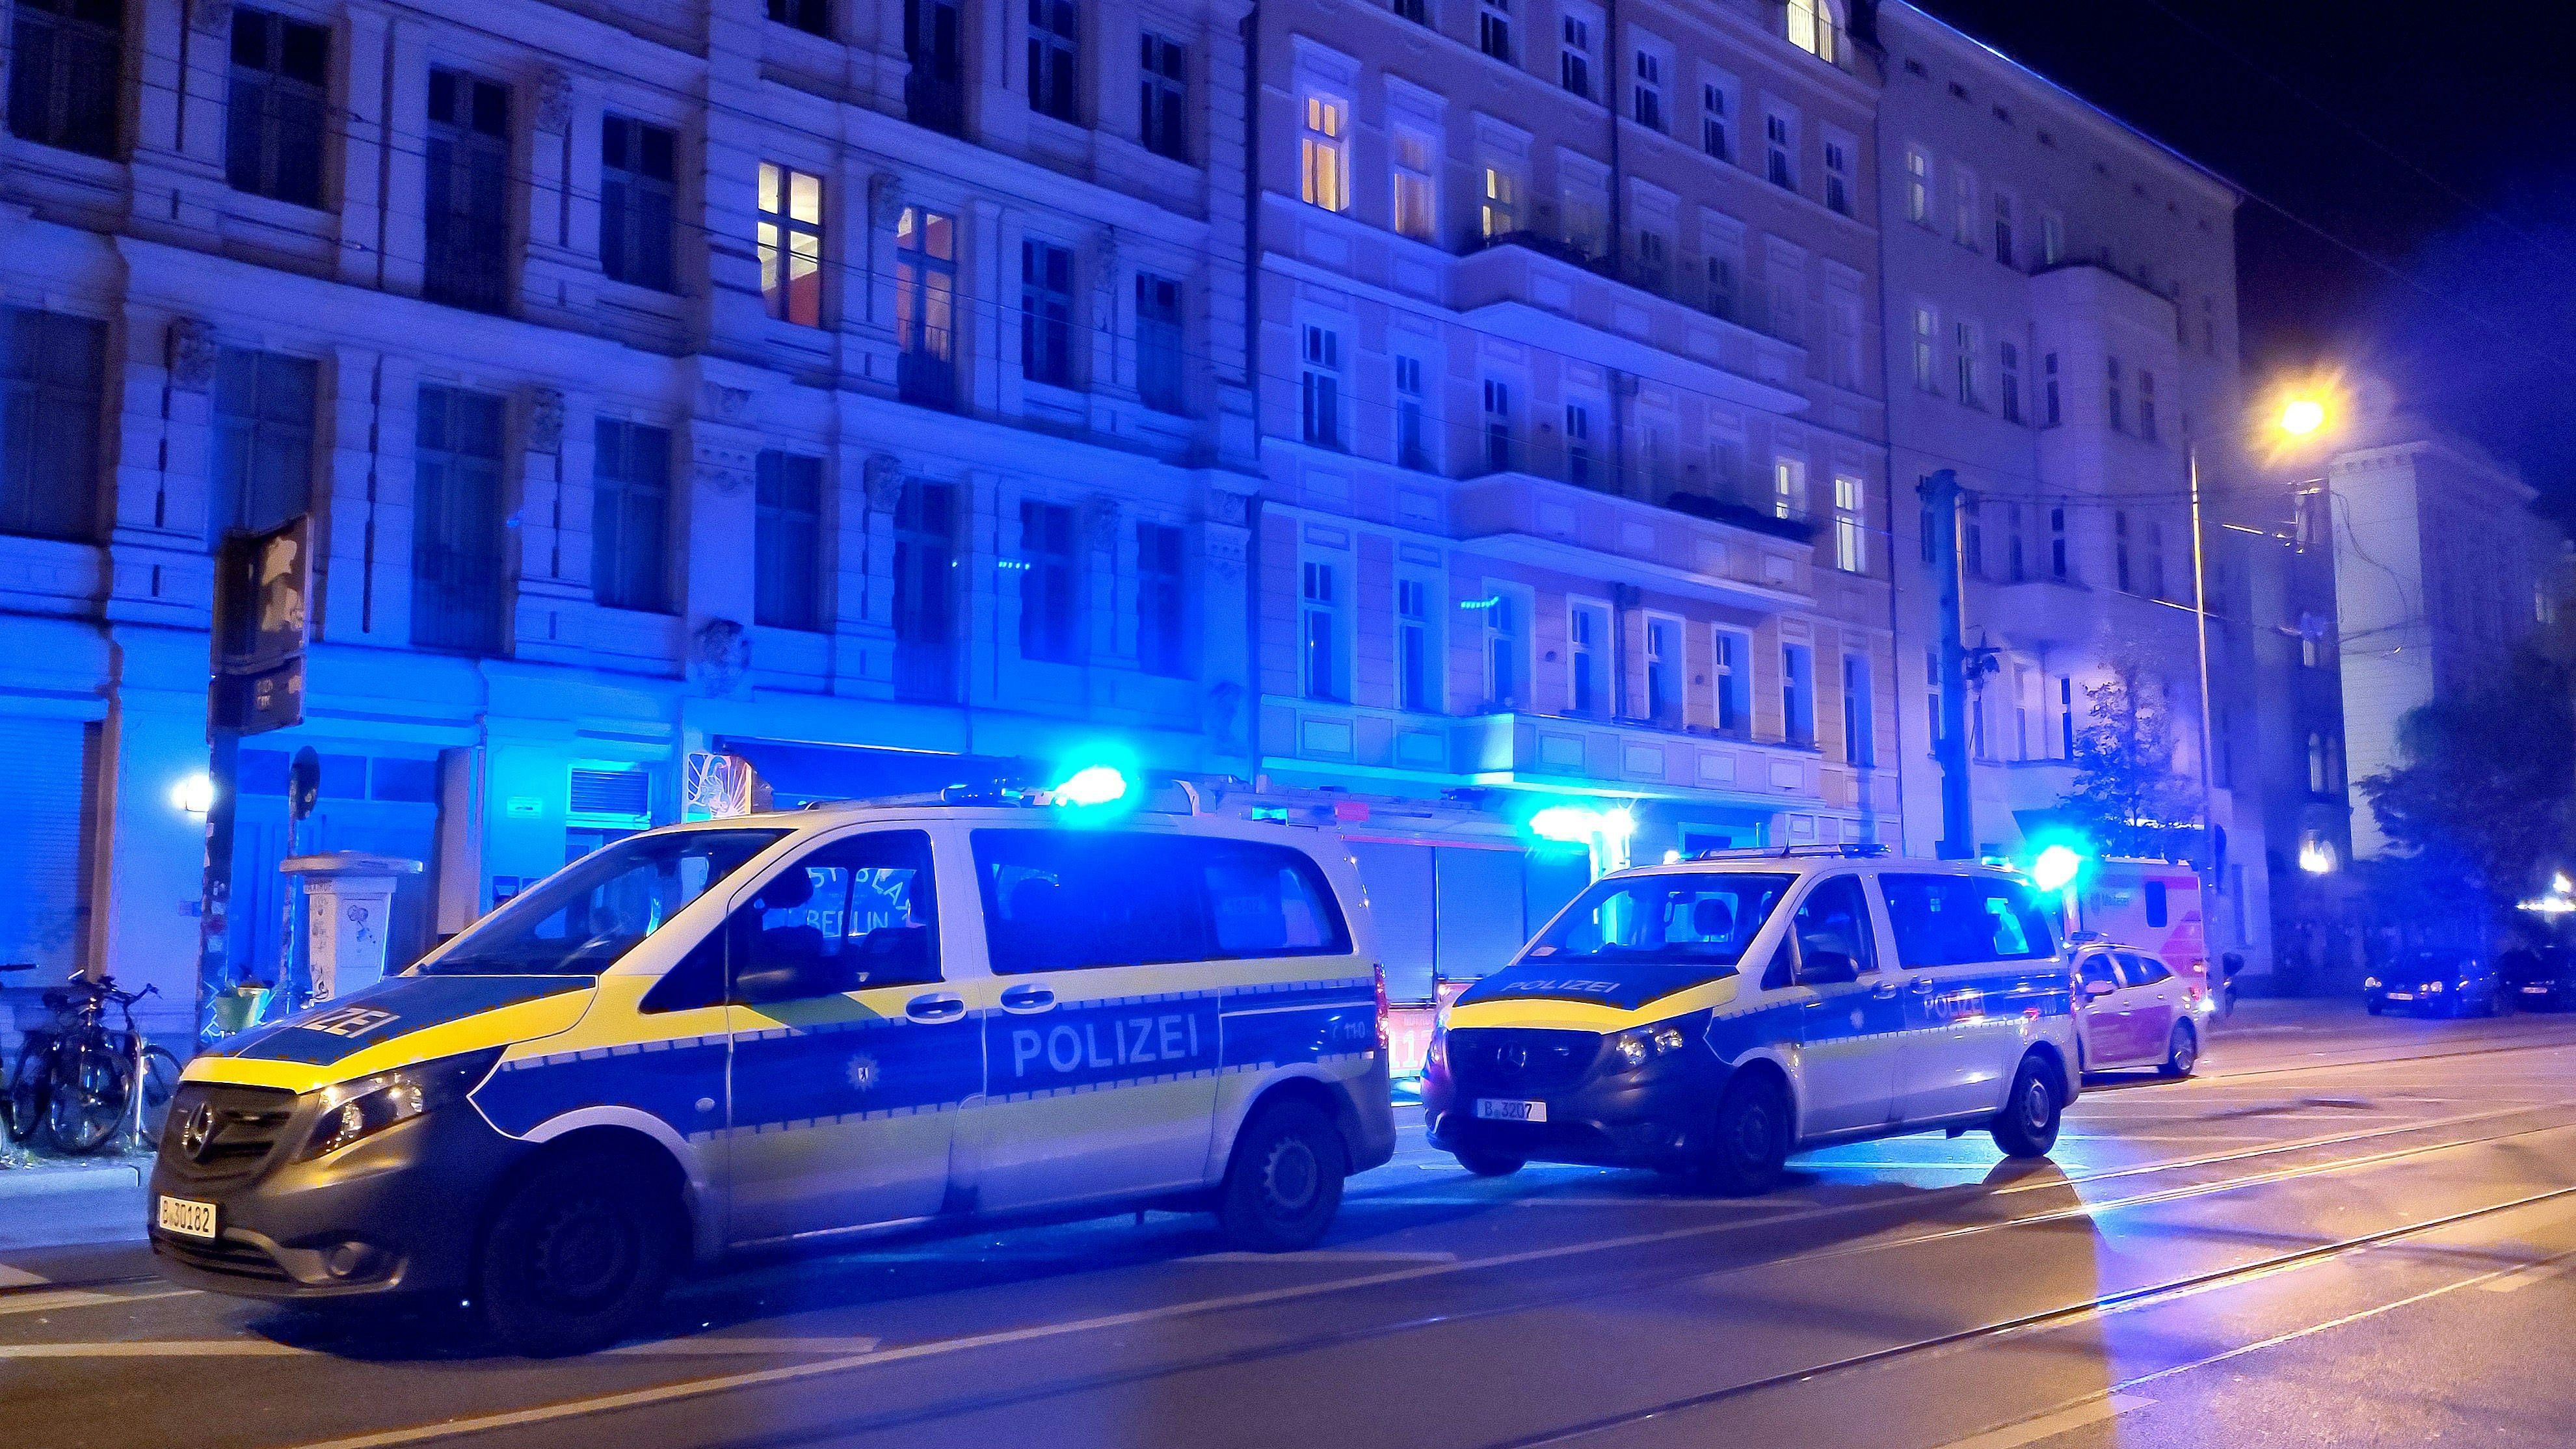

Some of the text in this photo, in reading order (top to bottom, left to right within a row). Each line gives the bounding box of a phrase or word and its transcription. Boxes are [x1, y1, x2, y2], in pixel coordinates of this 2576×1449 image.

[1500, 979, 1621, 994] POLIZEI
[1924, 992, 1985, 1018] POLIZEI
[1344, 1021, 1366, 1039] 110
[1013, 1014, 1197, 1077] POLIZEI
[1485, 1101, 1532, 1119] B 3207
[163, 1200, 209, 1233] B 30182
